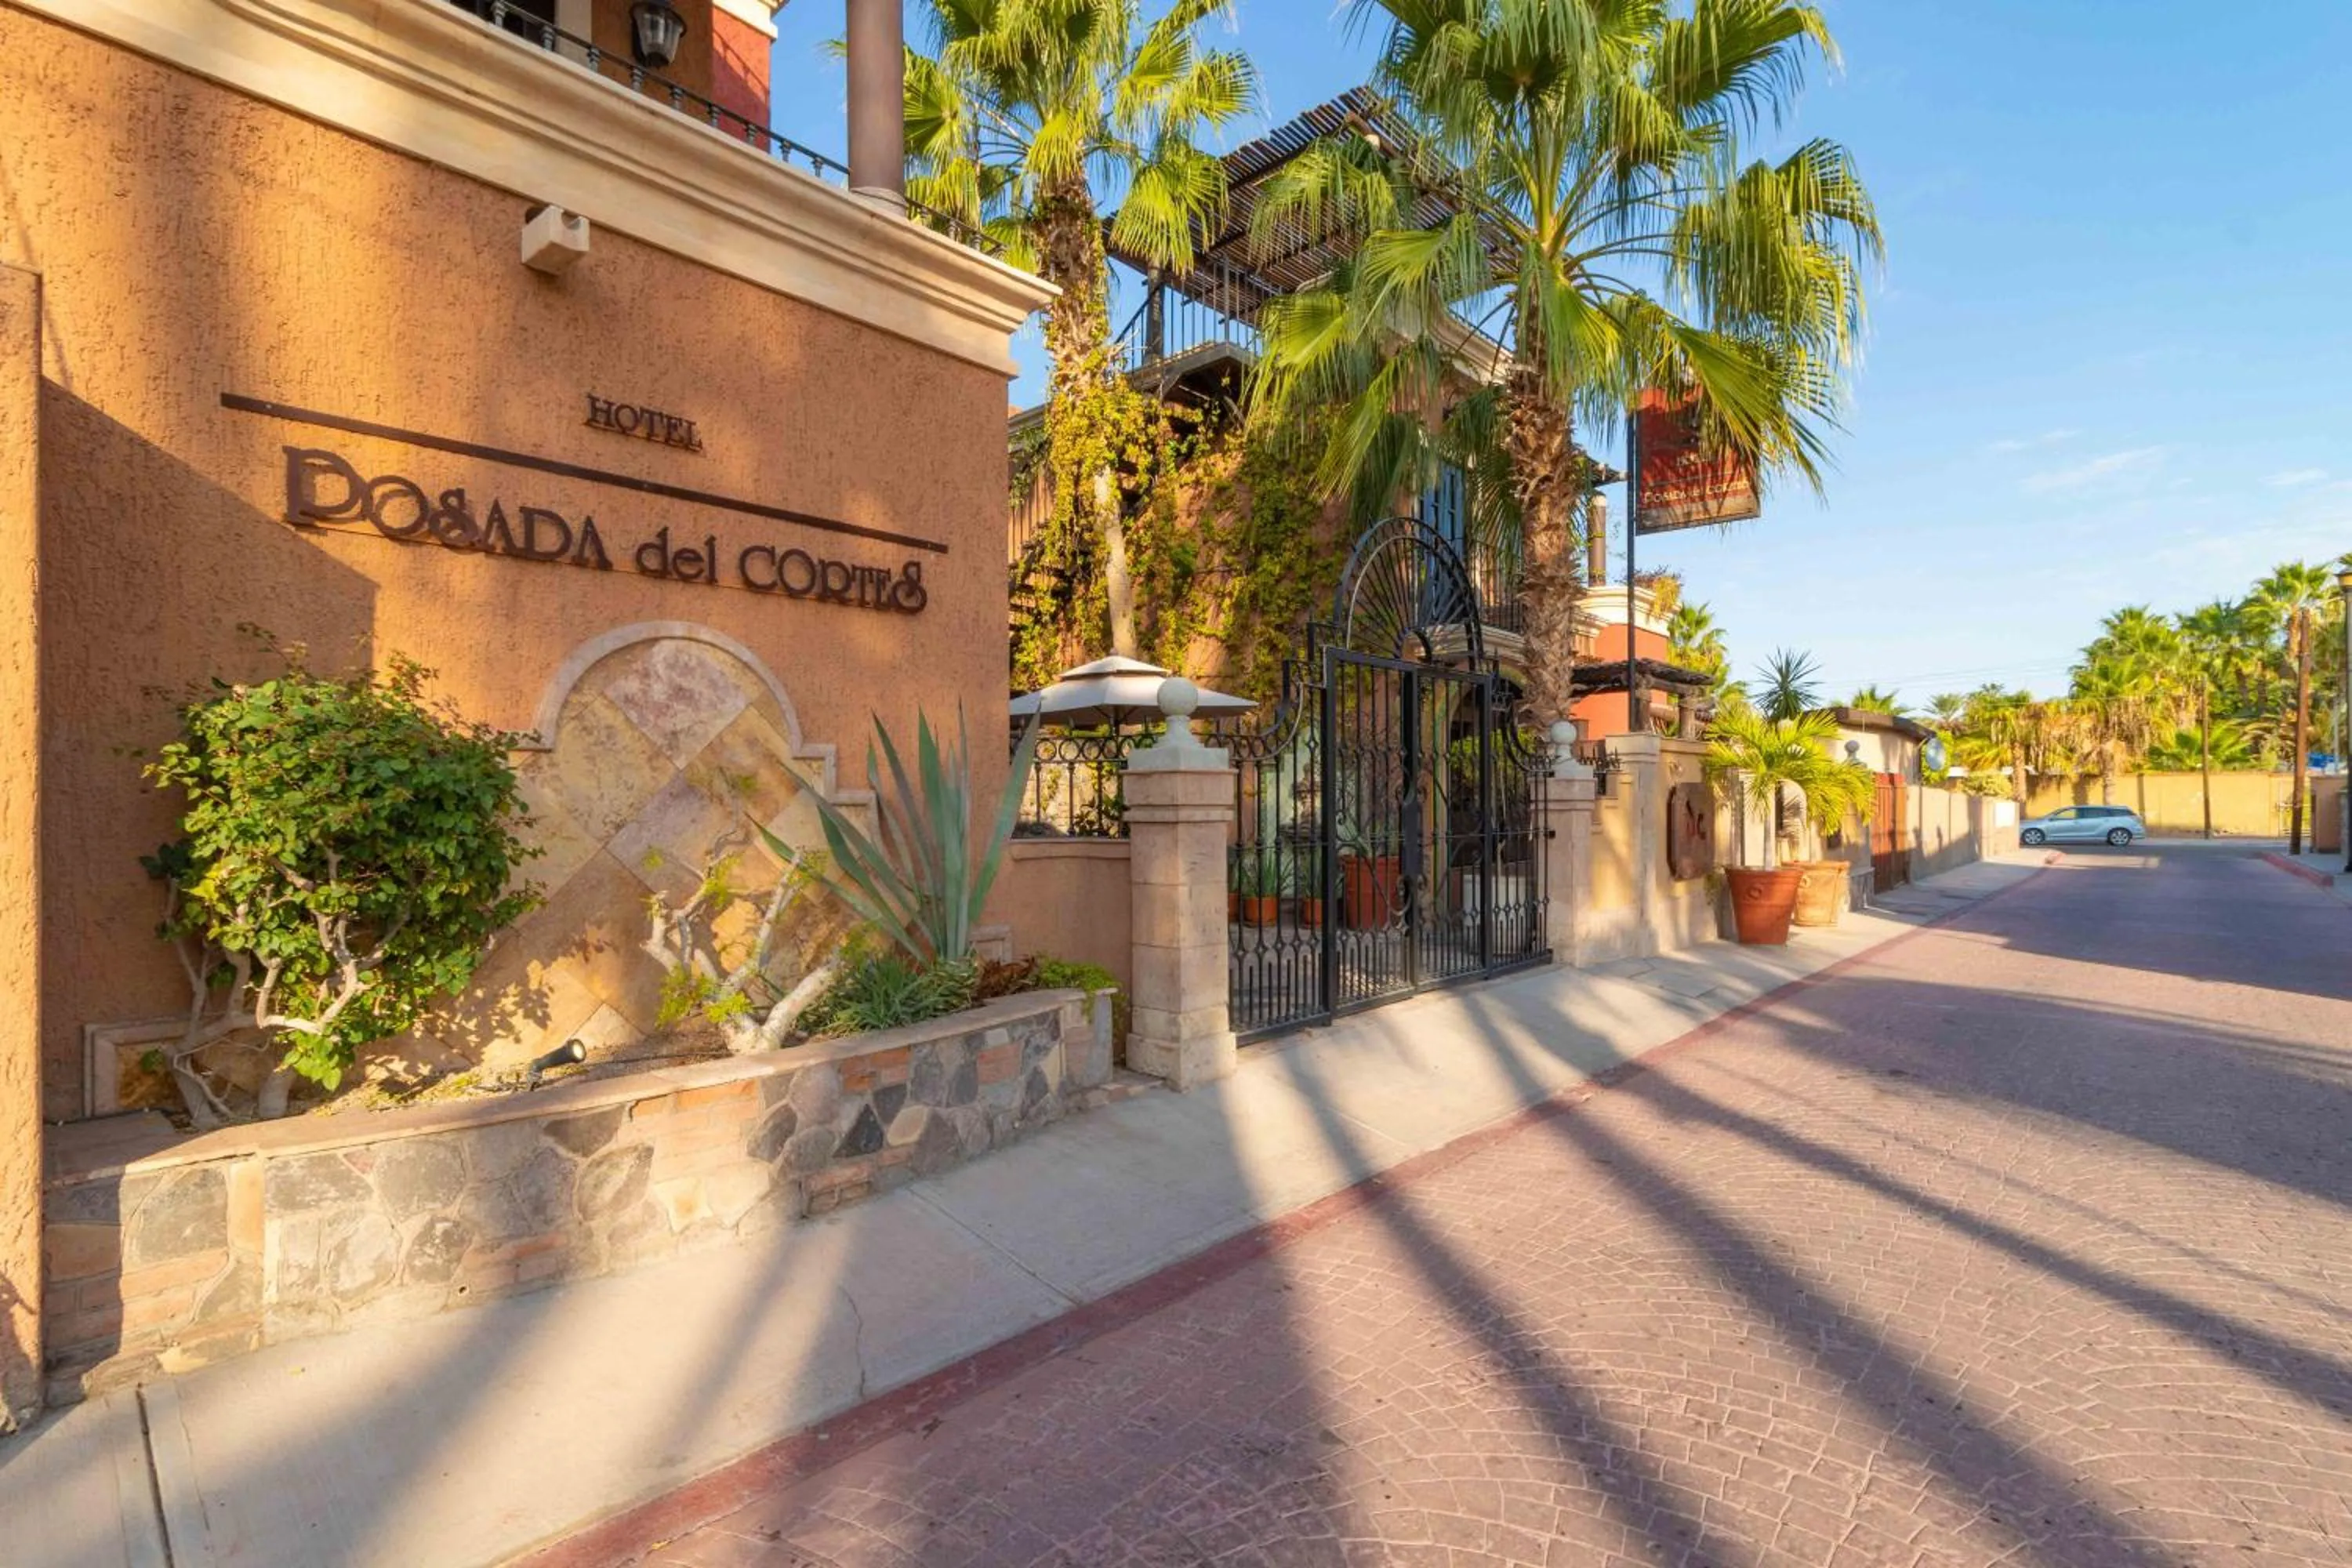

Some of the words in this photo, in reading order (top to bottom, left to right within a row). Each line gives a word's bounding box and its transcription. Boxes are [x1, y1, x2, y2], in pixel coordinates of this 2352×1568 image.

[586, 393, 703, 452] HOTEL
[282, 445, 613, 571] POSADA
[635, 526, 719, 585] del
[739, 545, 927, 614] CORTES
